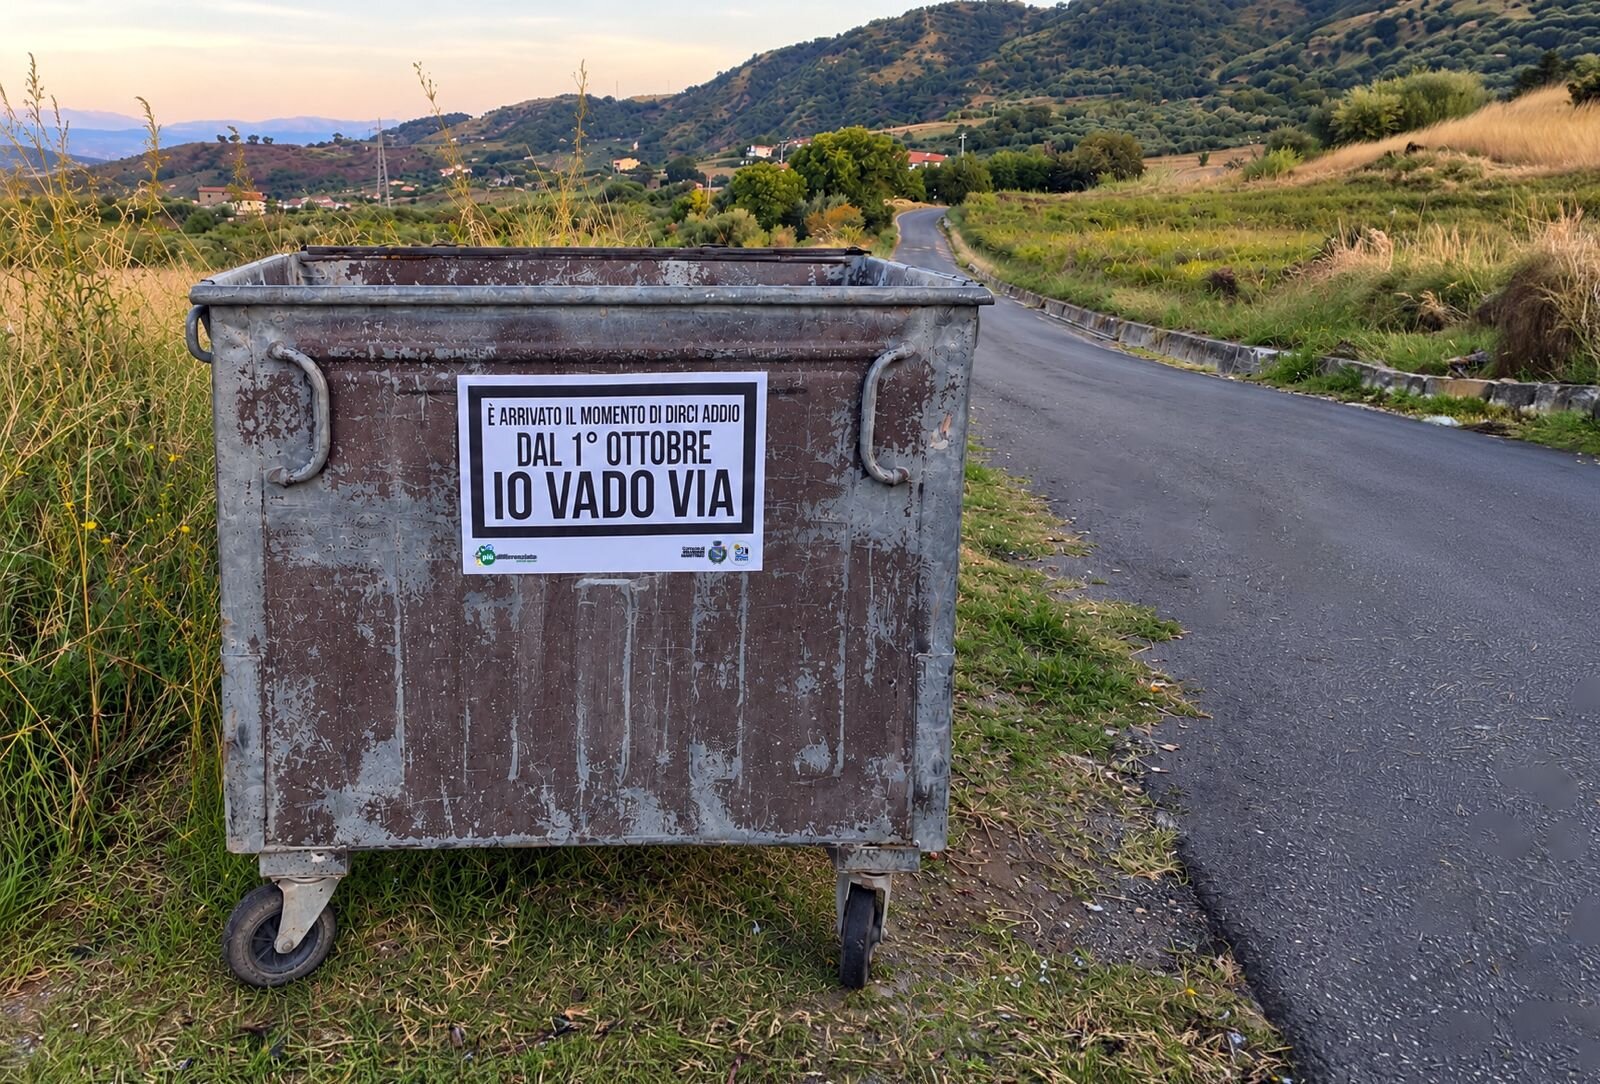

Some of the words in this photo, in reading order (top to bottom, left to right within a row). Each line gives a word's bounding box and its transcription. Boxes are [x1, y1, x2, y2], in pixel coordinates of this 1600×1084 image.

[488, 403, 495, 425] È
[500, 407, 561, 425] ARRIVATO
[566, 407, 576, 425] IL
[581, 406, 645, 424] MOMENTO
[650, 405, 661, 423] DI
[666, 405, 698, 423] DIRCI
[702, 405, 739, 422] ADDIO
[517, 433, 562, 466] DAL
[572, 432, 597, 466] 1°
[607, 430, 711, 466] OTTOBRE
[494, 471, 532, 520] IO
[546, 470, 654, 519] VADO
[668, 469, 734, 517] VIA
